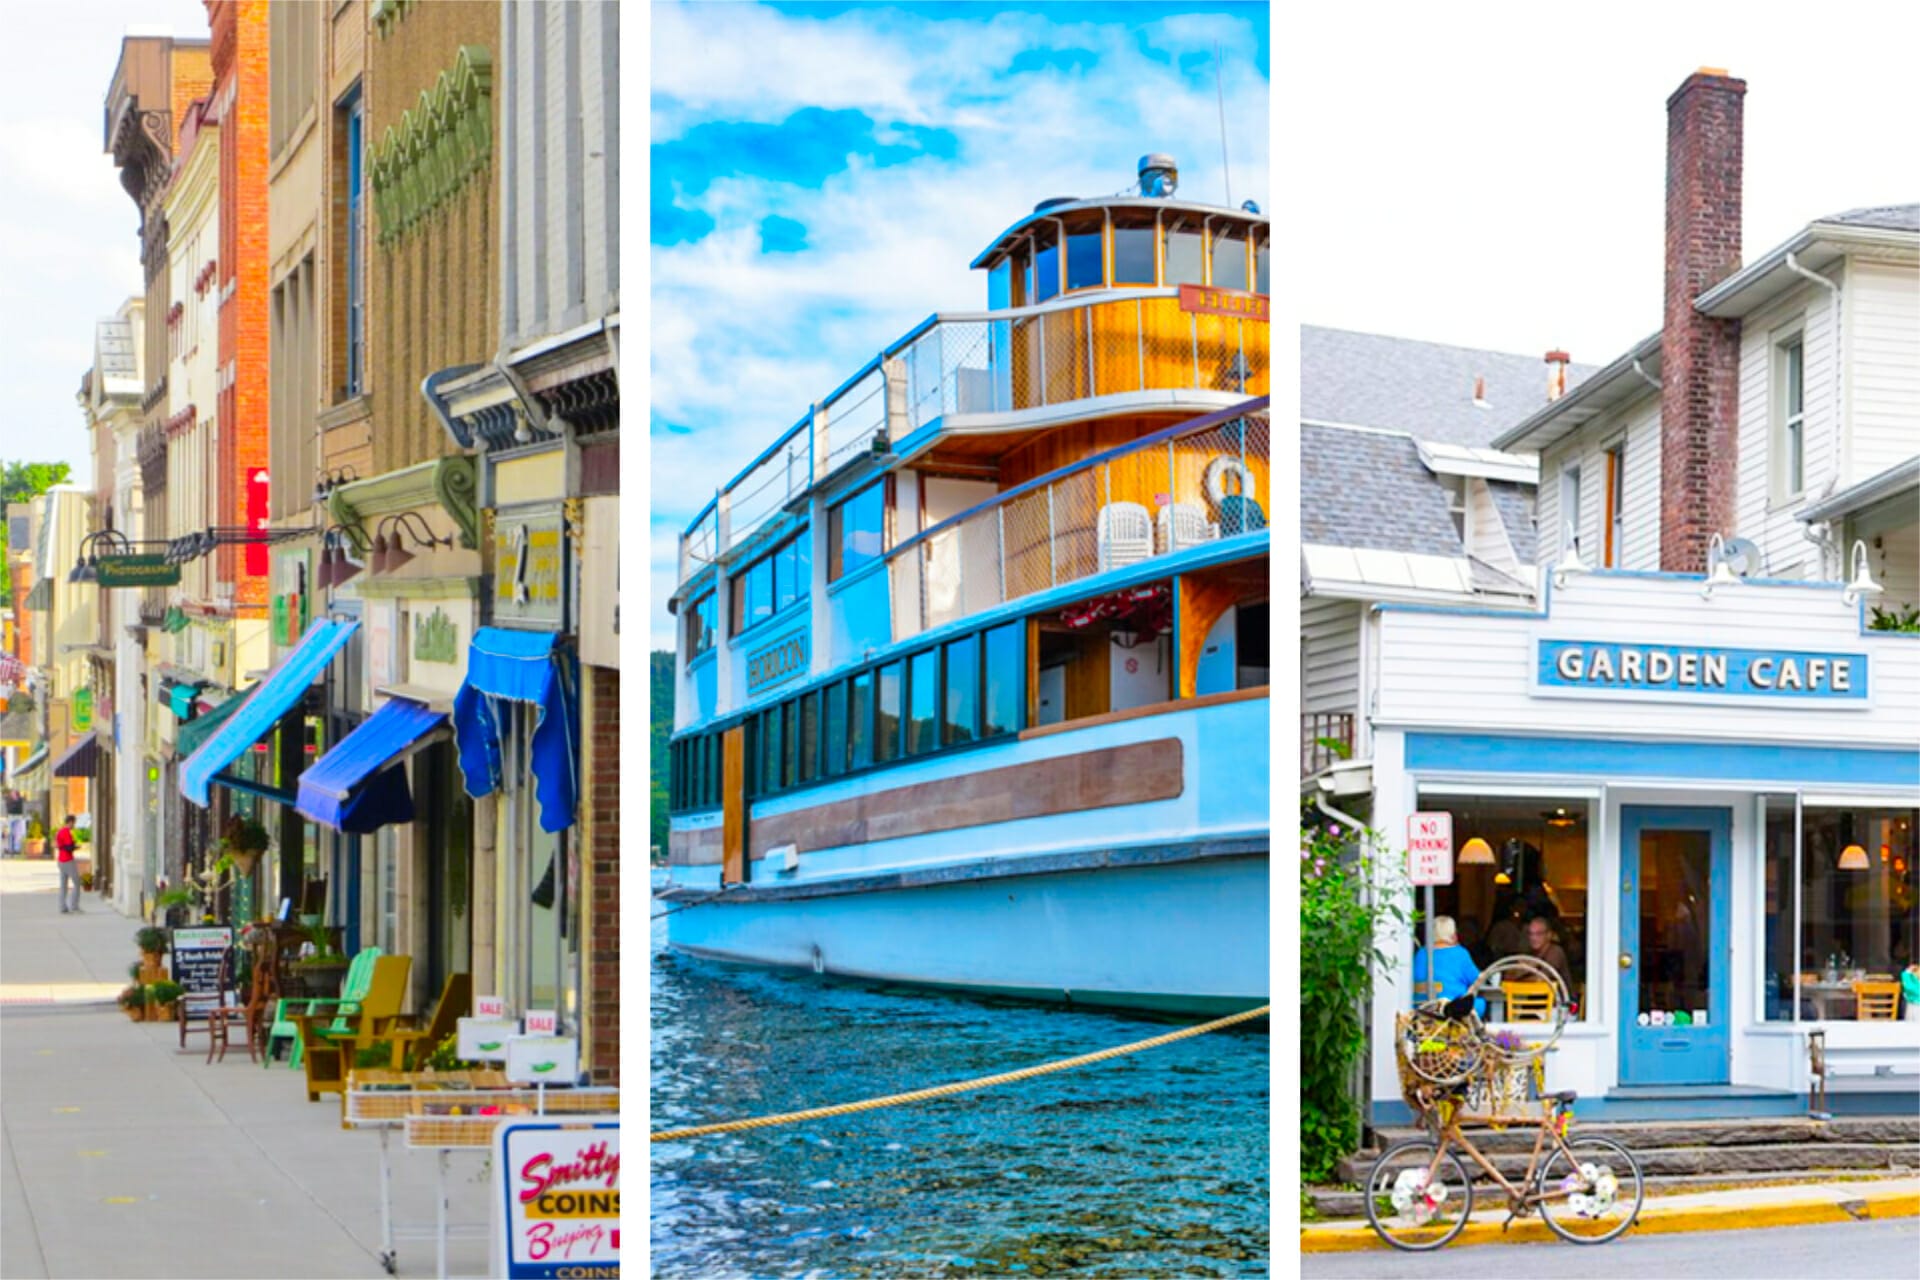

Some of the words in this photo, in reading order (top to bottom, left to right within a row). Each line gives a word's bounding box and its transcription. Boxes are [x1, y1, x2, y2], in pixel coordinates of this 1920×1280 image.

[1199, 290, 1270, 315] HOR
[749, 636, 805, 688] HORICON
[1557, 647, 1728, 687] GARDEN
[1749, 657, 1850, 691] CAFE
[1420, 821, 1437, 835] NO
[1408, 838, 1449, 851] PARKING
[1421, 854, 1438, 863] ANY
[1420, 866, 1440, 877] TIME
[479, 1002, 503, 1016] SALE
[527, 1017, 553, 1031] SALE
[526, 1222, 603, 1260] Buying
